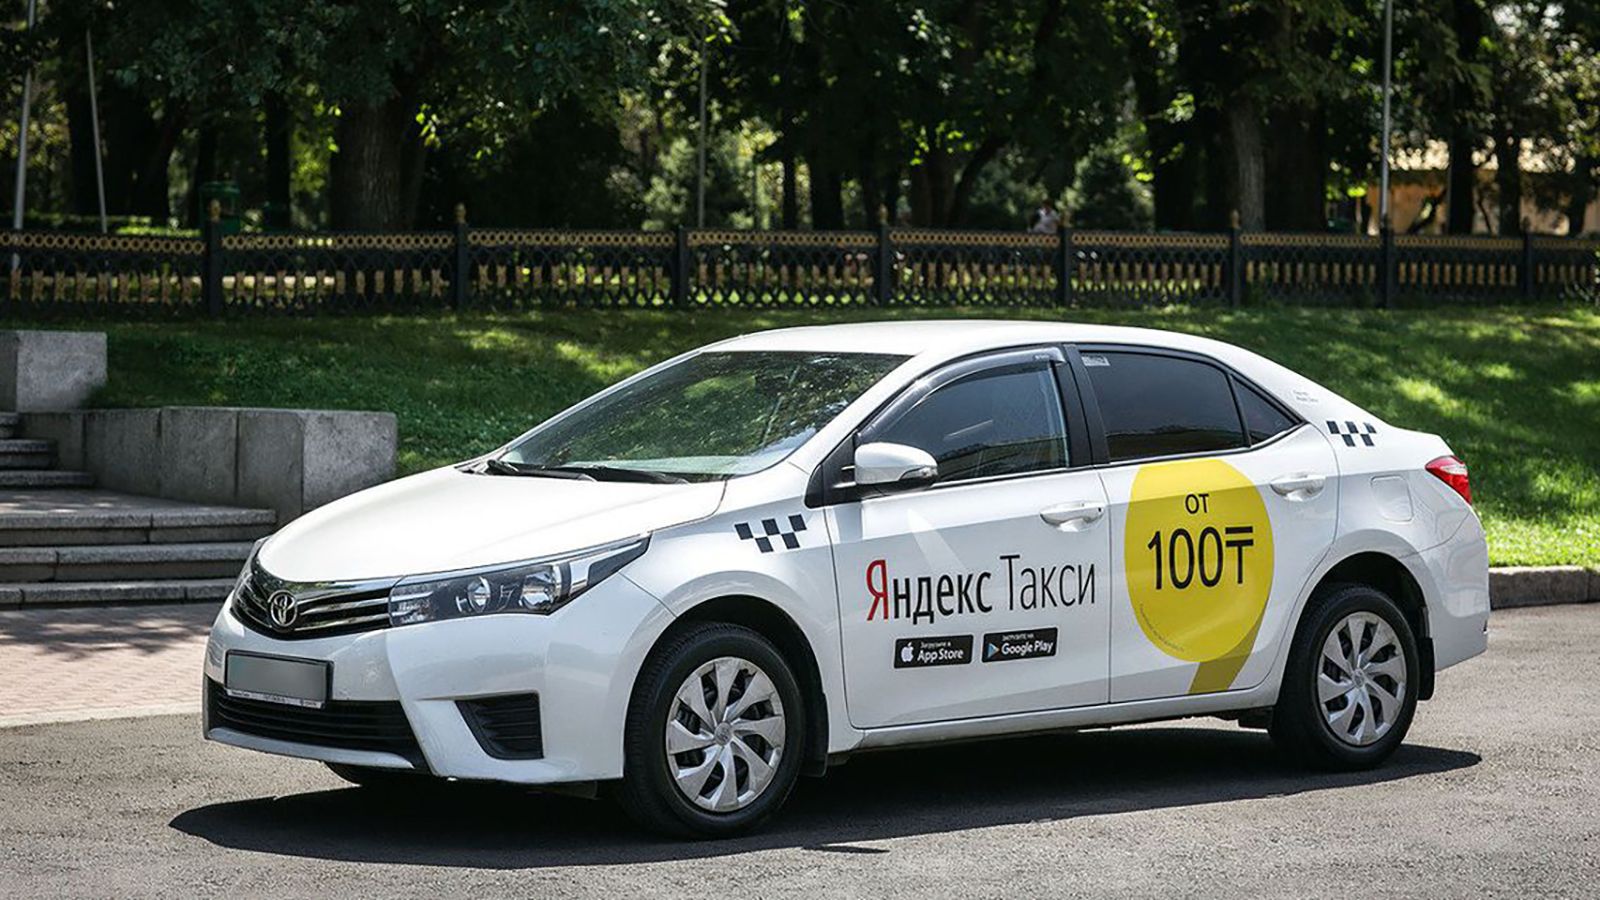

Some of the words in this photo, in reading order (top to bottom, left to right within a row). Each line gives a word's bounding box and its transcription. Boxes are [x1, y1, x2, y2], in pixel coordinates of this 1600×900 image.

[1185, 493, 1209, 514] ОТ
[866, 559, 993, 625] Яндекс
[1000, 554, 1096, 611] Такси
[917, 650, 938, 664] App
[938, 648, 965, 661] Store
[1001, 641, 1033, 656] Google
[1033, 639, 1054, 653] Play
